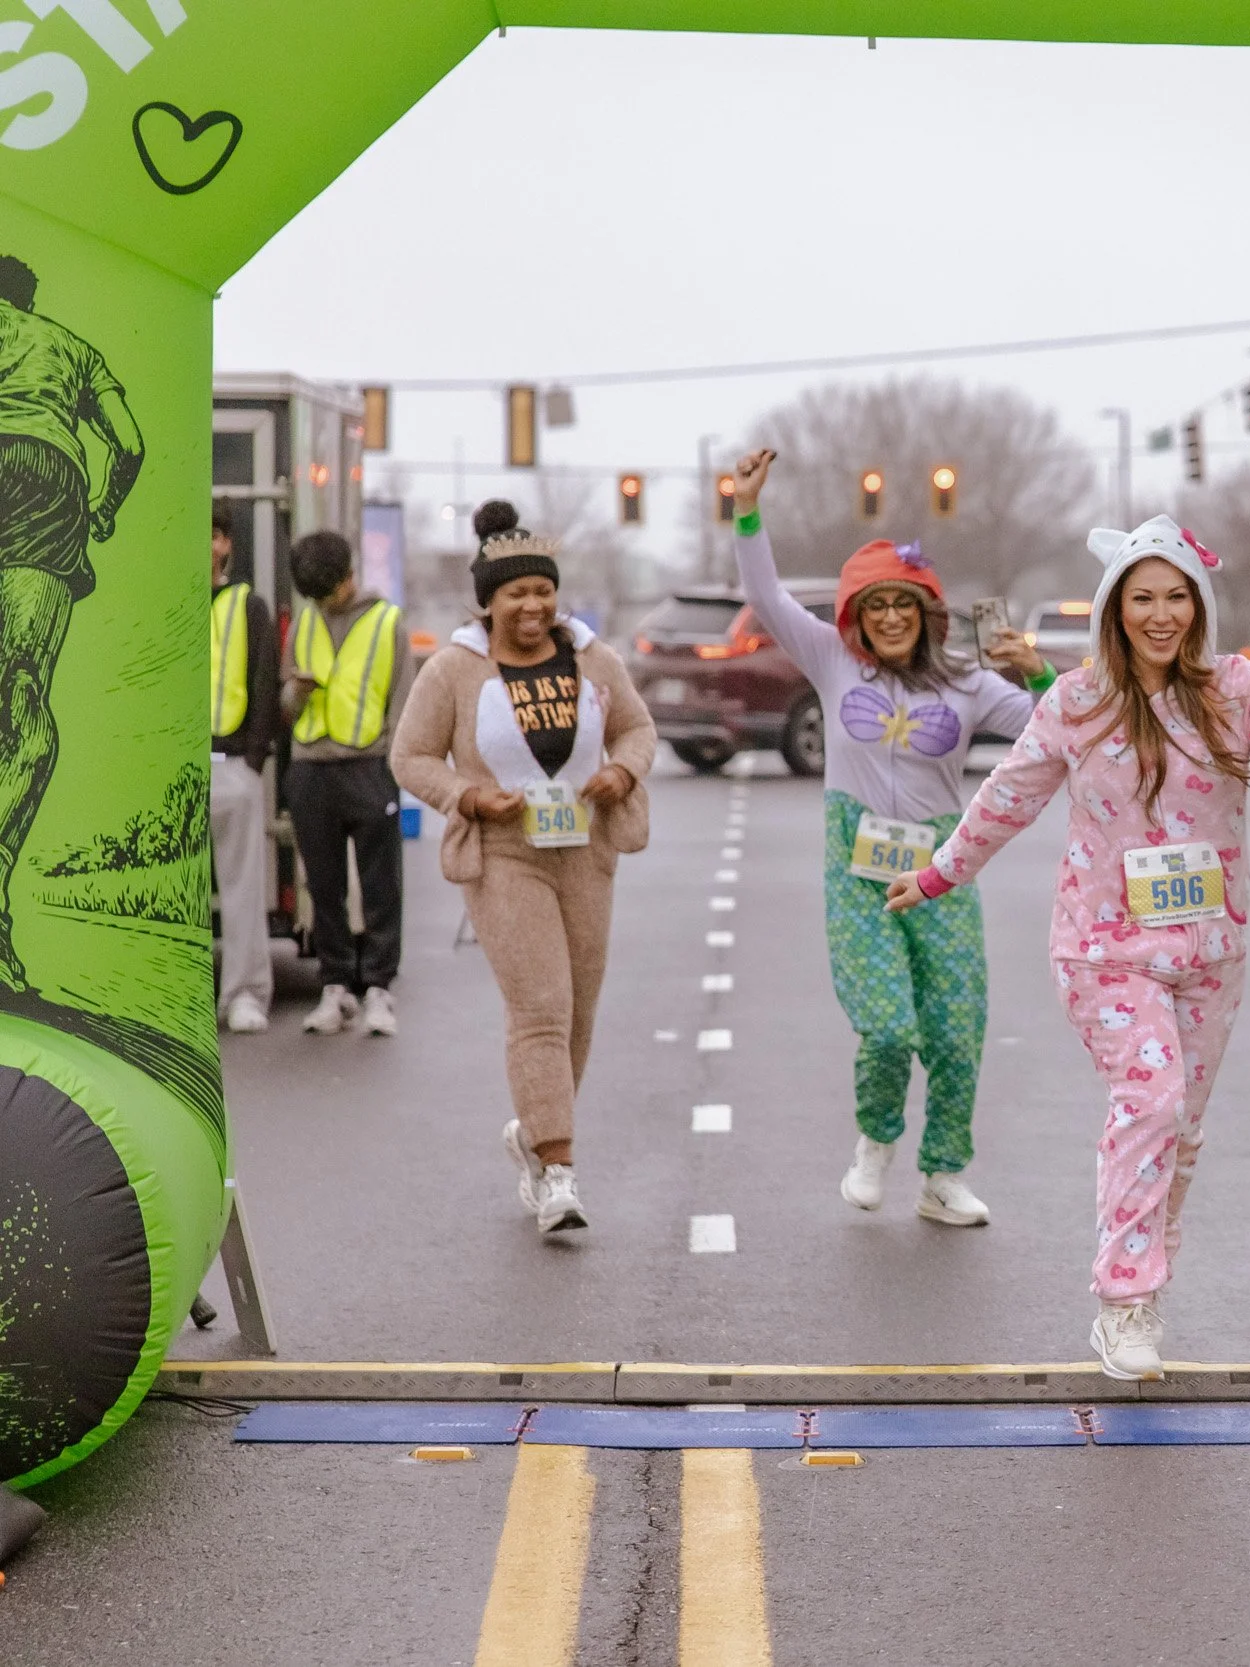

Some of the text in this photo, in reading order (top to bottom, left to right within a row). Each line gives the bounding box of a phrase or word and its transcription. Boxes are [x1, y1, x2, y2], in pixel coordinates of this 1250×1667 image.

[537, 807, 575, 832] 549
[871, 843, 915, 871] 548
[1151, 875, 1204, 910] 596
